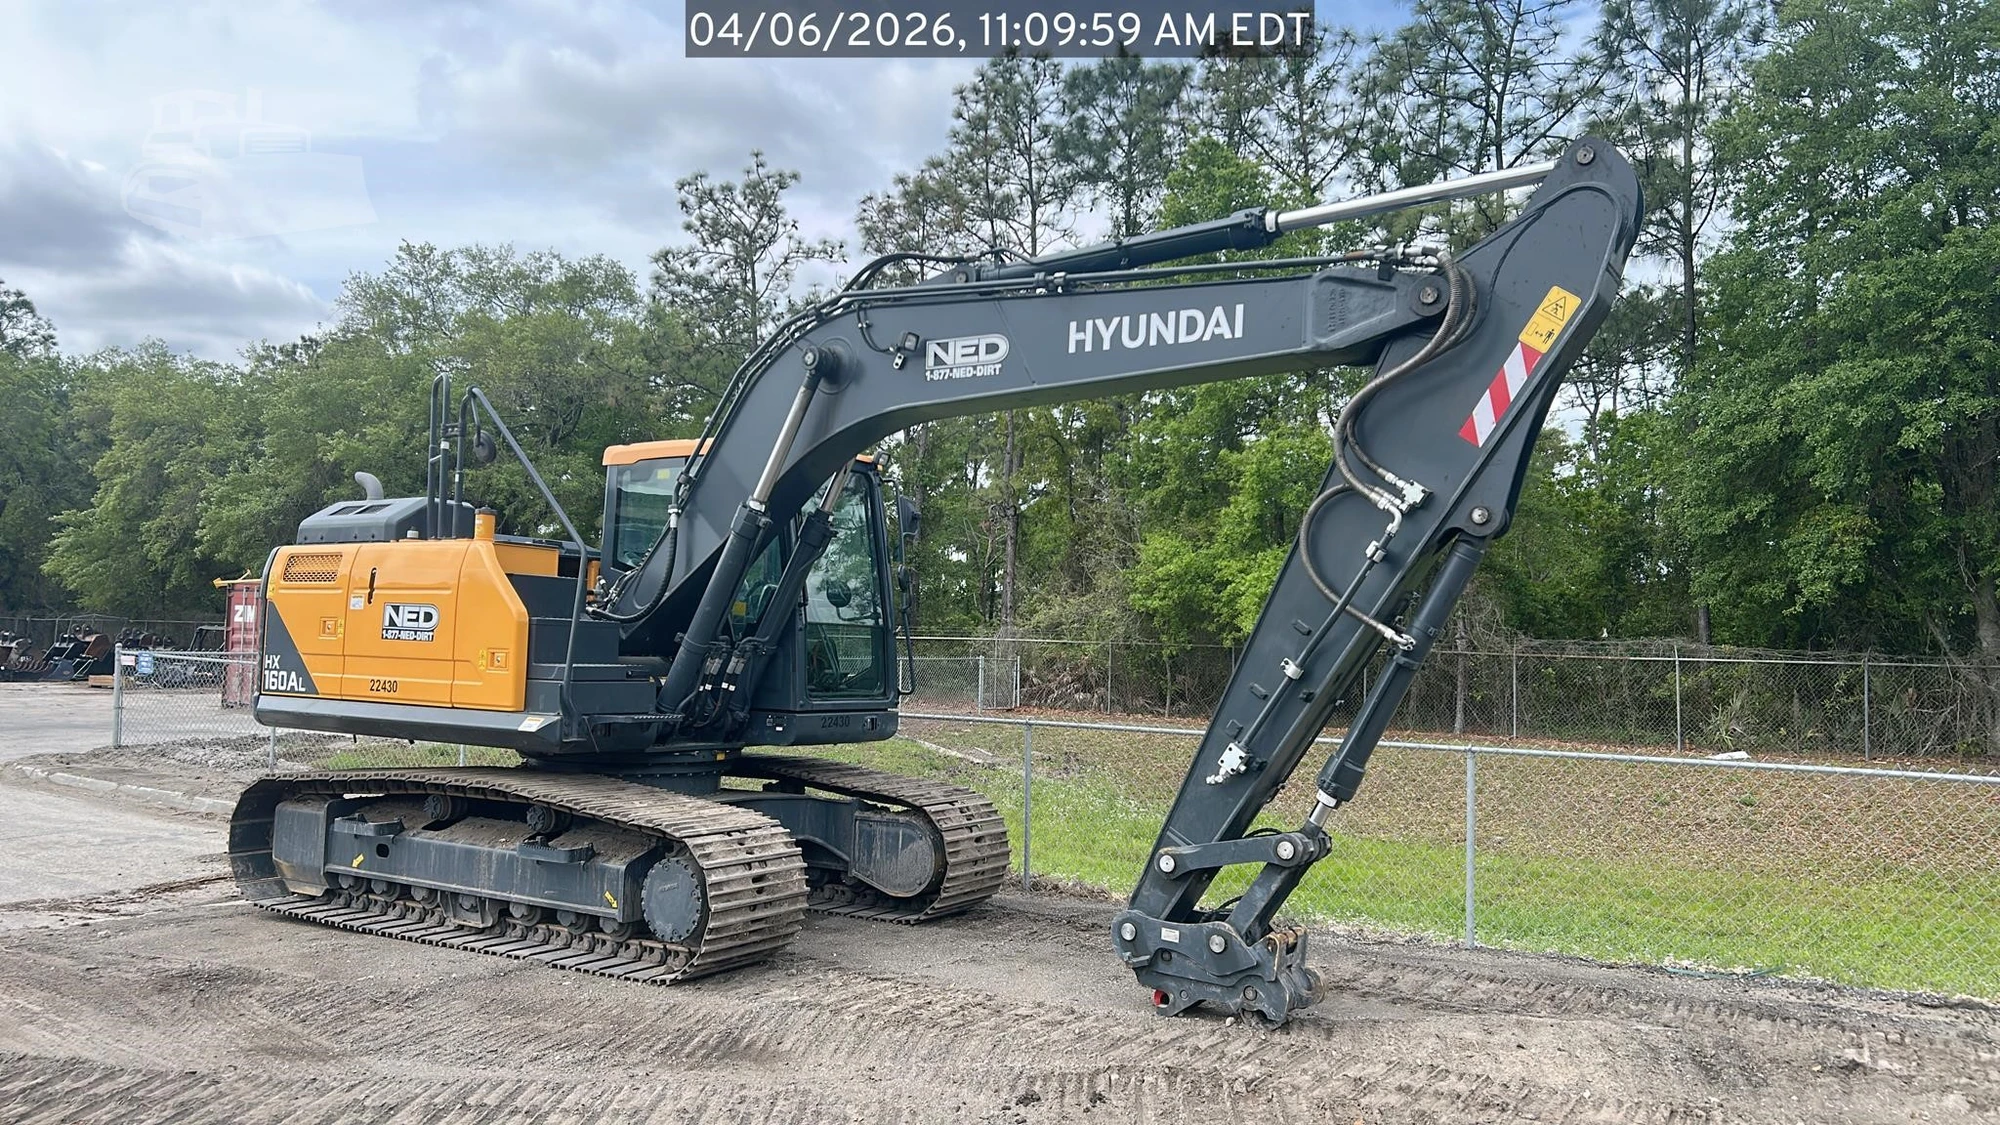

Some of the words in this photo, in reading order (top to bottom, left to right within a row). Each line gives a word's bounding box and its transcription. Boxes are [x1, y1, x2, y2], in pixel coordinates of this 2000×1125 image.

[1067, 303, 1245, 353] HYUNDAI
[926, 337, 1008, 367] NED
[925, 364, 1002, 381] 1-877-NED-DIRT
[383, 603, 439, 629] NED
[381, 629, 435, 642] 1-877-NED-DIRT
[265, 655, 281, 669] HX
[264, 671, 306, 693] 160AL
[369, 679, 399, 693] 22430
[821, 715, 850, 729] 22430
